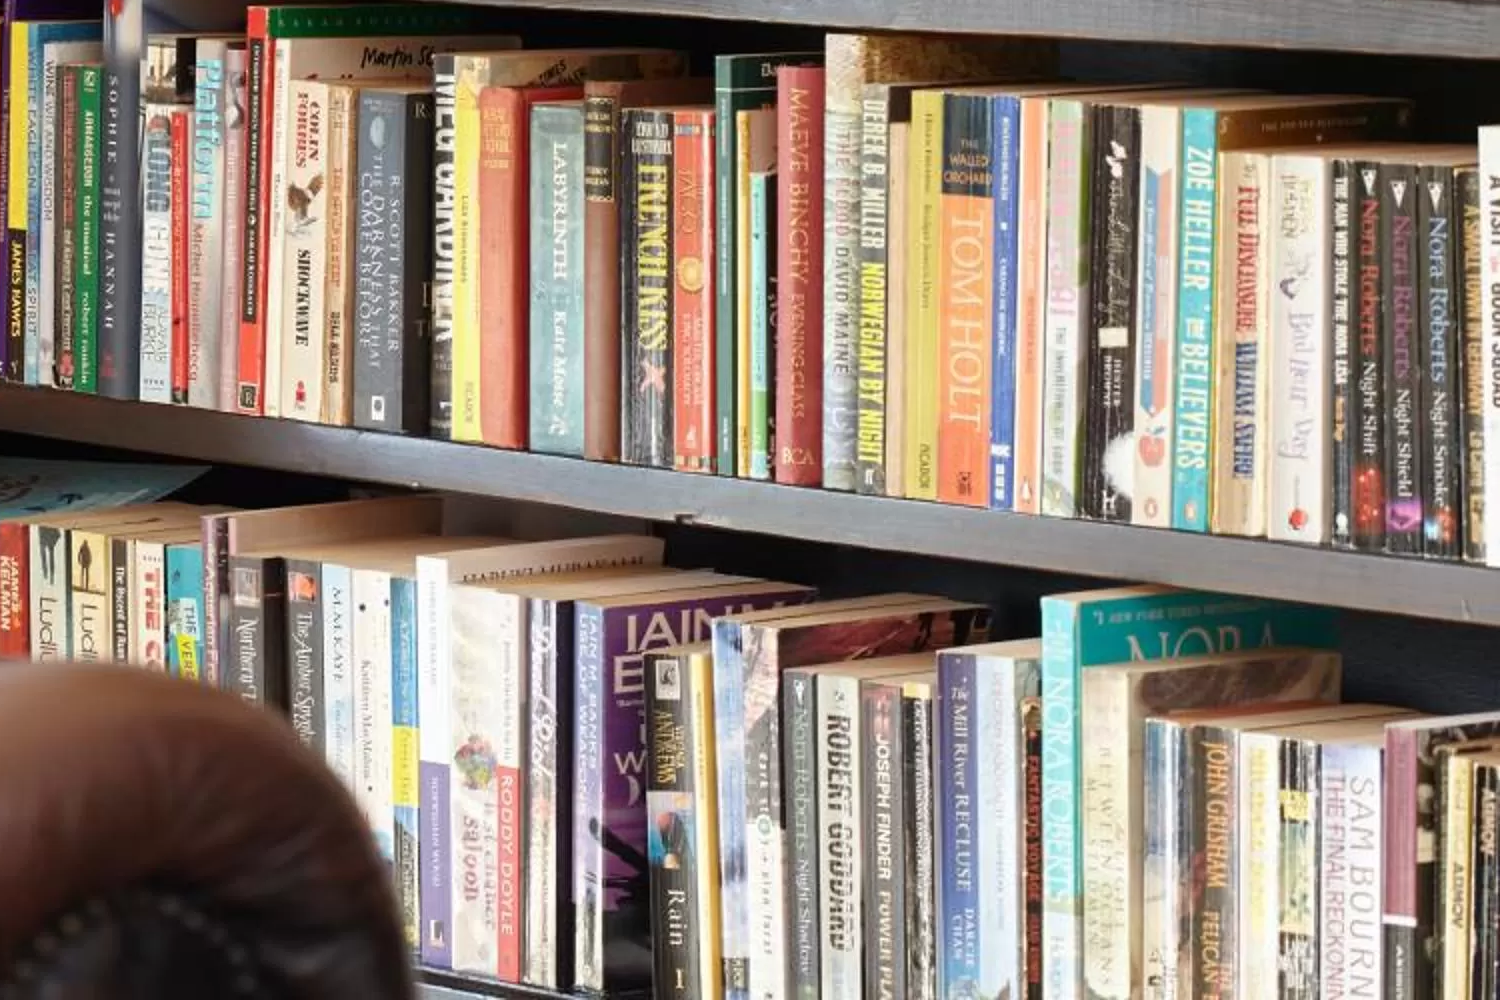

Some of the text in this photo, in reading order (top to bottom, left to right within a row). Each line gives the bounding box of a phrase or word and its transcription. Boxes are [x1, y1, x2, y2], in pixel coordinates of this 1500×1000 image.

[107, 74, 118, 164] SOPHIE
[362, 44, 412, 67] Martin
[195, 59, 223, 219] Platform
[309, 102, 320, 161] COLIN
[788, 87, 808, 284] MAEVE BINCHY
[553, 142, 568, 280] LABYRINTH
[637, 163, 669, 350] FRENCH KISS
[1182, 147, 1215, 289] ZOË HELLER
[11, 240, 22, 337] JAMES HAWES
[105, 231, 116, 330] HANNAH
[296, 249, 310, 346] SHOCKWAVE
[859, 99, 885, 463] DEREK B. MILLER NORWEGIAN BY NIGHT
[948, 213, 983, 431] TOM HOLT
[1361, 200, 1379, 455] Nora Roberts Night Shift
[1177, 343, 1211, 469] BELIEVERS
[1393, 215, 1412, 497] Nora Roberts Night Shield
[1429, 216, 1448, 507] Nora Roberts Night Smoke
[0, 555, 10, 631] KELMAN
[9, 556, 19, 614] JAMES
[146, 568, 161, 630] THE
[239, 619, 257, 686] Northern
[298, 612, 313, 637] The
[656, 710, 675, 783] ANDREWS
[876, 736, 891, 879] JOSEPH FINDER
[954, 705, 970, 892] Mill River RECLUSE
[1044, 674, 1074, 903] NORA ROBERTS
[1204, 742, 1227, 888] JOHN GRISHAM
[1350, 776, 1374, 850] SAM
[501, 776, 514, 934] RODDY DOYLE
[827, 716, 854, 951] ROBERT GODDARD
[667, 890, 686, 945] Rain
